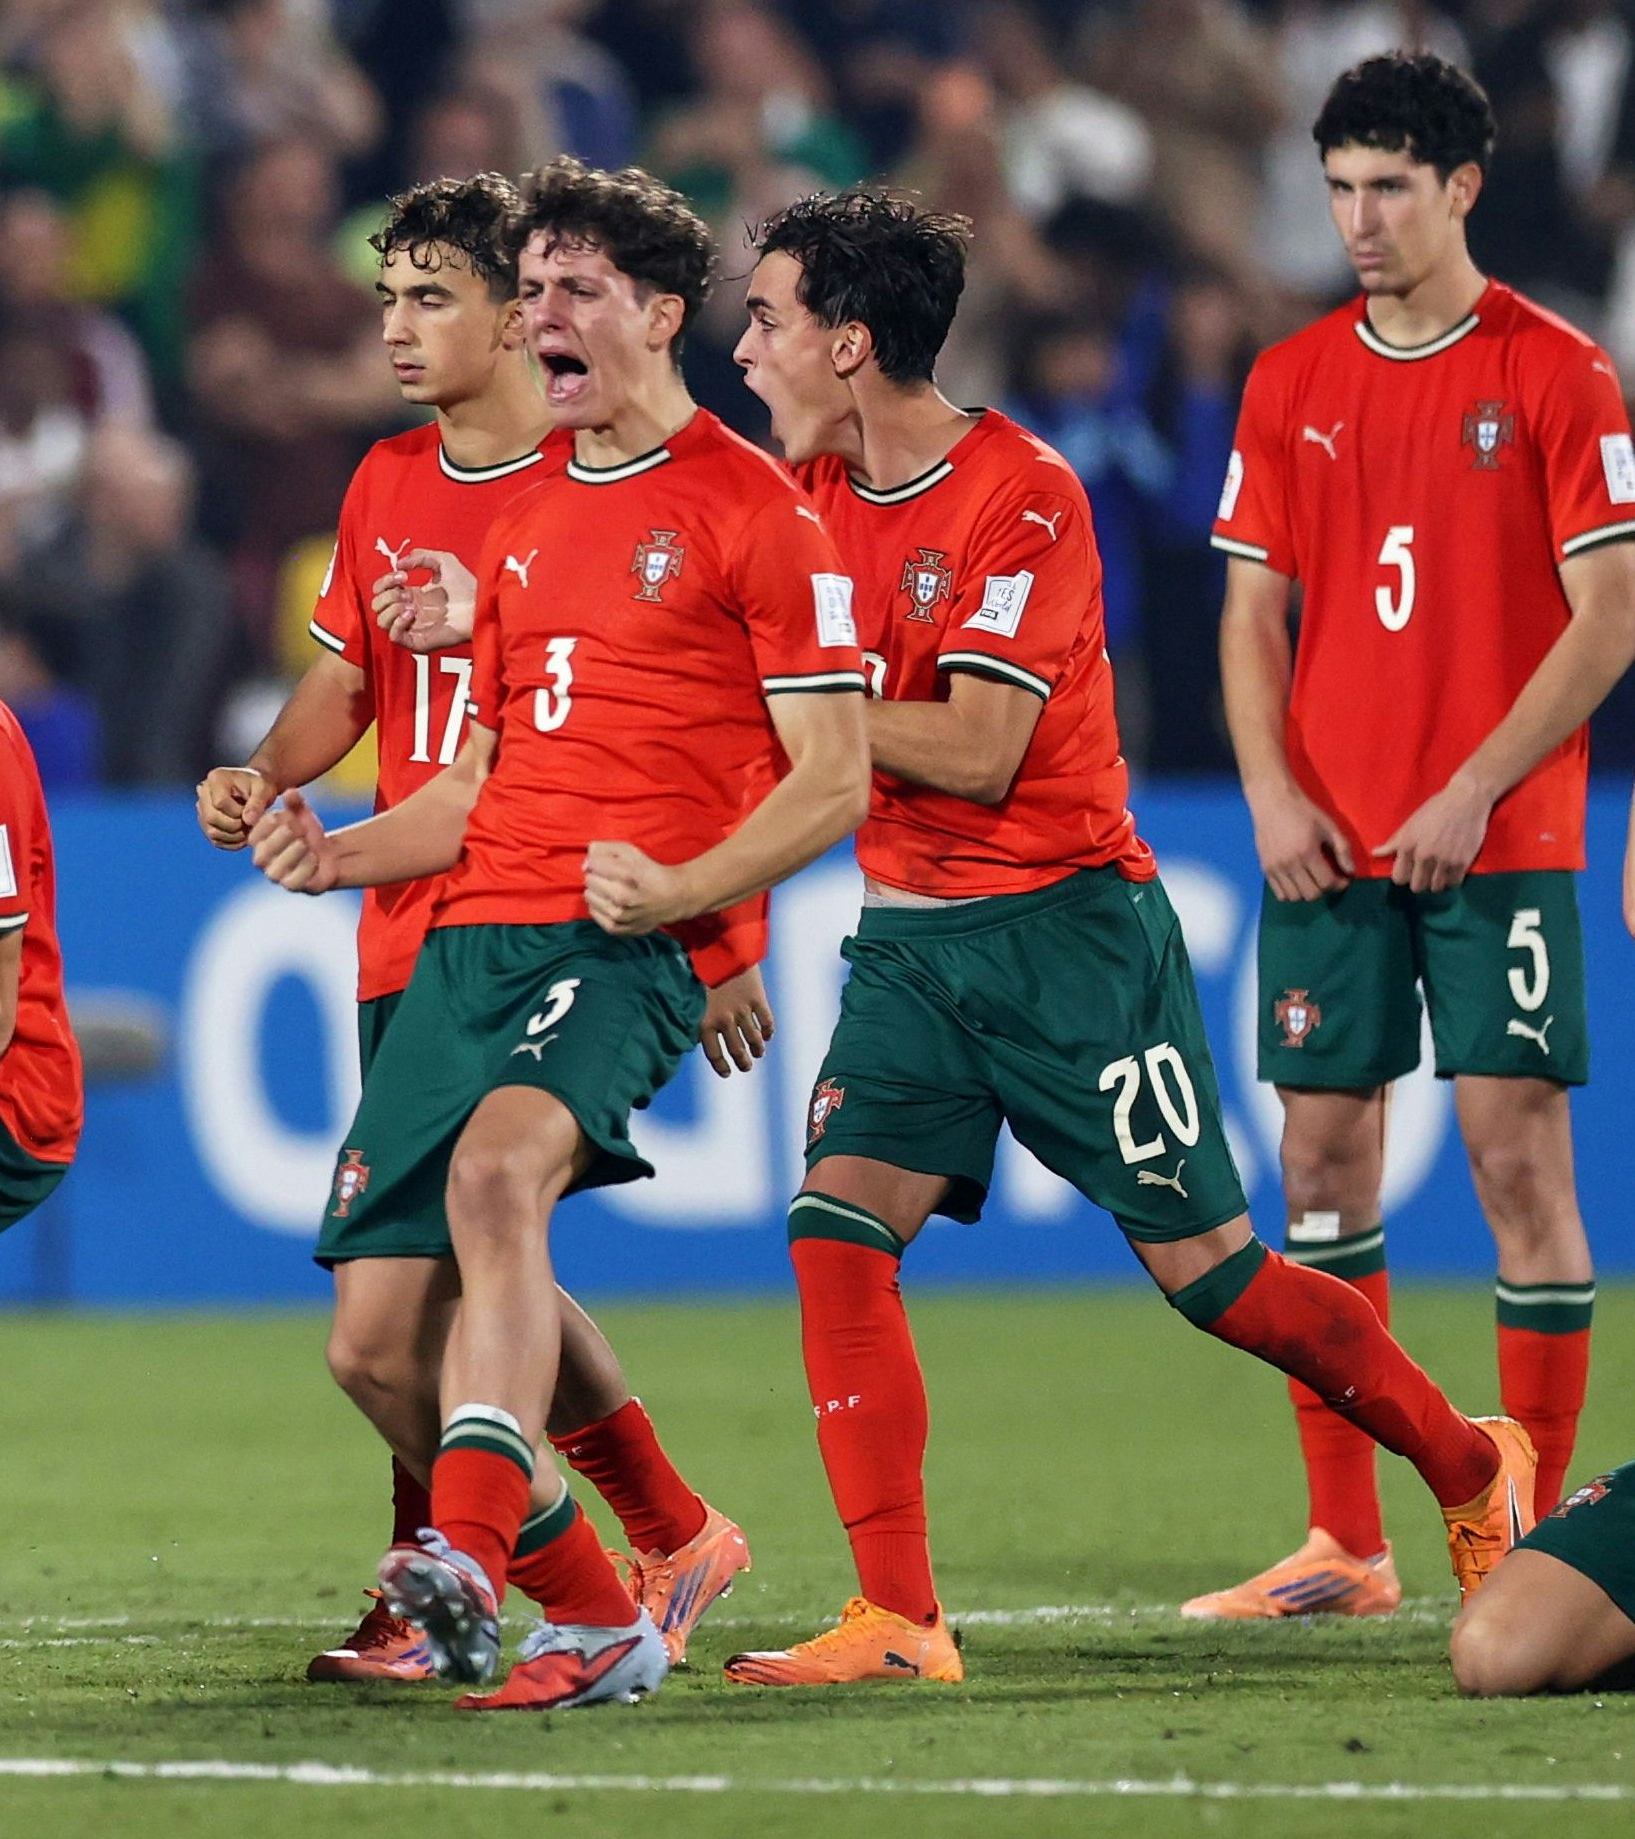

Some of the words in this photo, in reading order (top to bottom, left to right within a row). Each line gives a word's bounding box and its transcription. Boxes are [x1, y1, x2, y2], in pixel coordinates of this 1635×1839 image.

[1374, 524, 1416, 632] 5
[408, 653, 472, 765] 17
[533, 636, 577, 733] 3
[526, 977, 582, 1037] 3
[1506, 908, 1551, 1013] 5
[1097, 1040, 1201, 1165] 20
